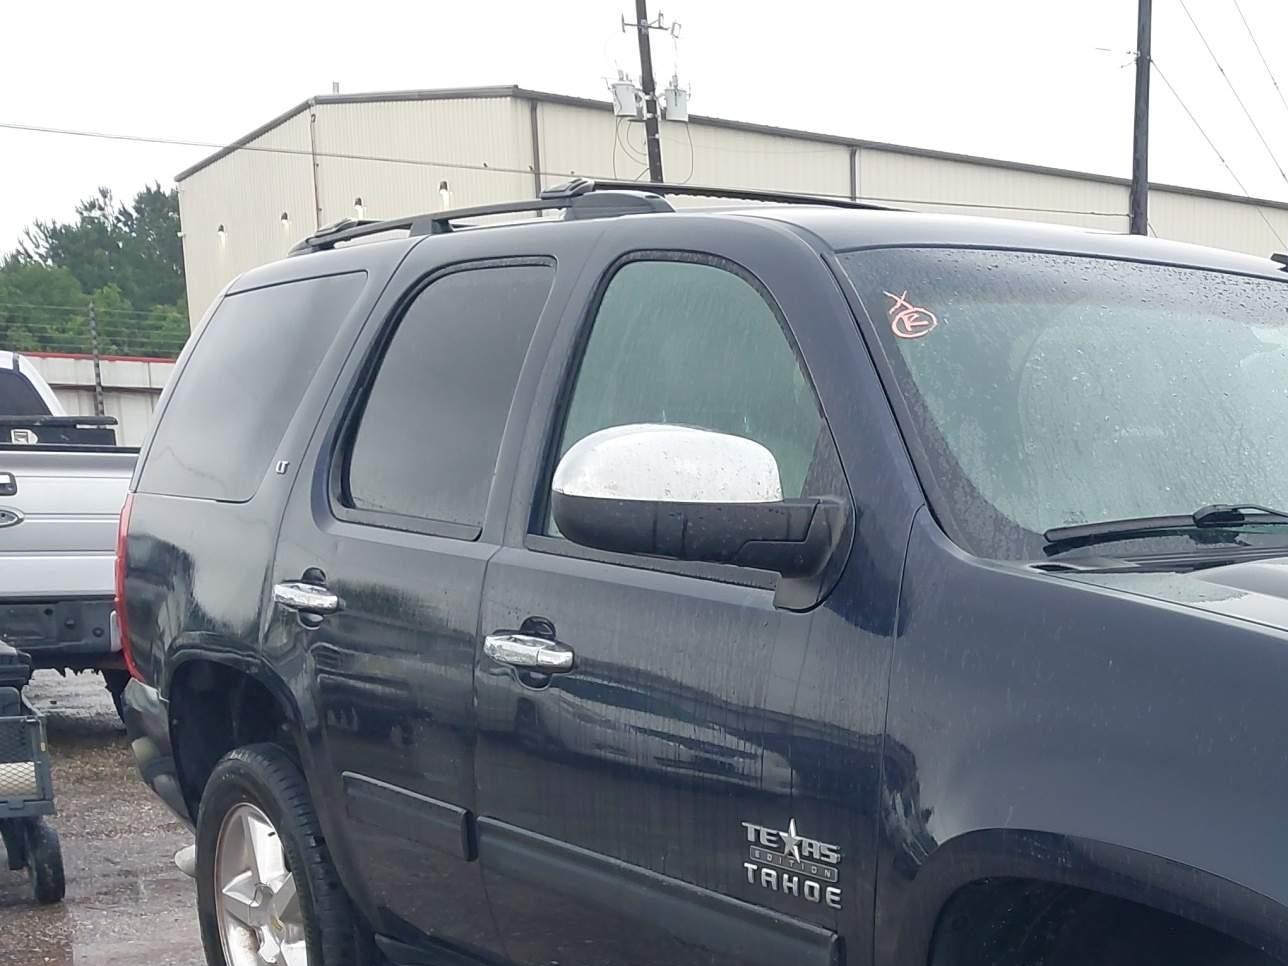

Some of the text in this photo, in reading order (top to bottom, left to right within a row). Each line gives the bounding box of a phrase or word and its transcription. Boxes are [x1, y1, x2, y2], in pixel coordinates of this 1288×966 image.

[275, 460, 290, 475] LT
[741, 818, 841, 864] TEXAS
[753, 849, 833, 880] EDITION
[743, 861, 843, 910] TAHOE
